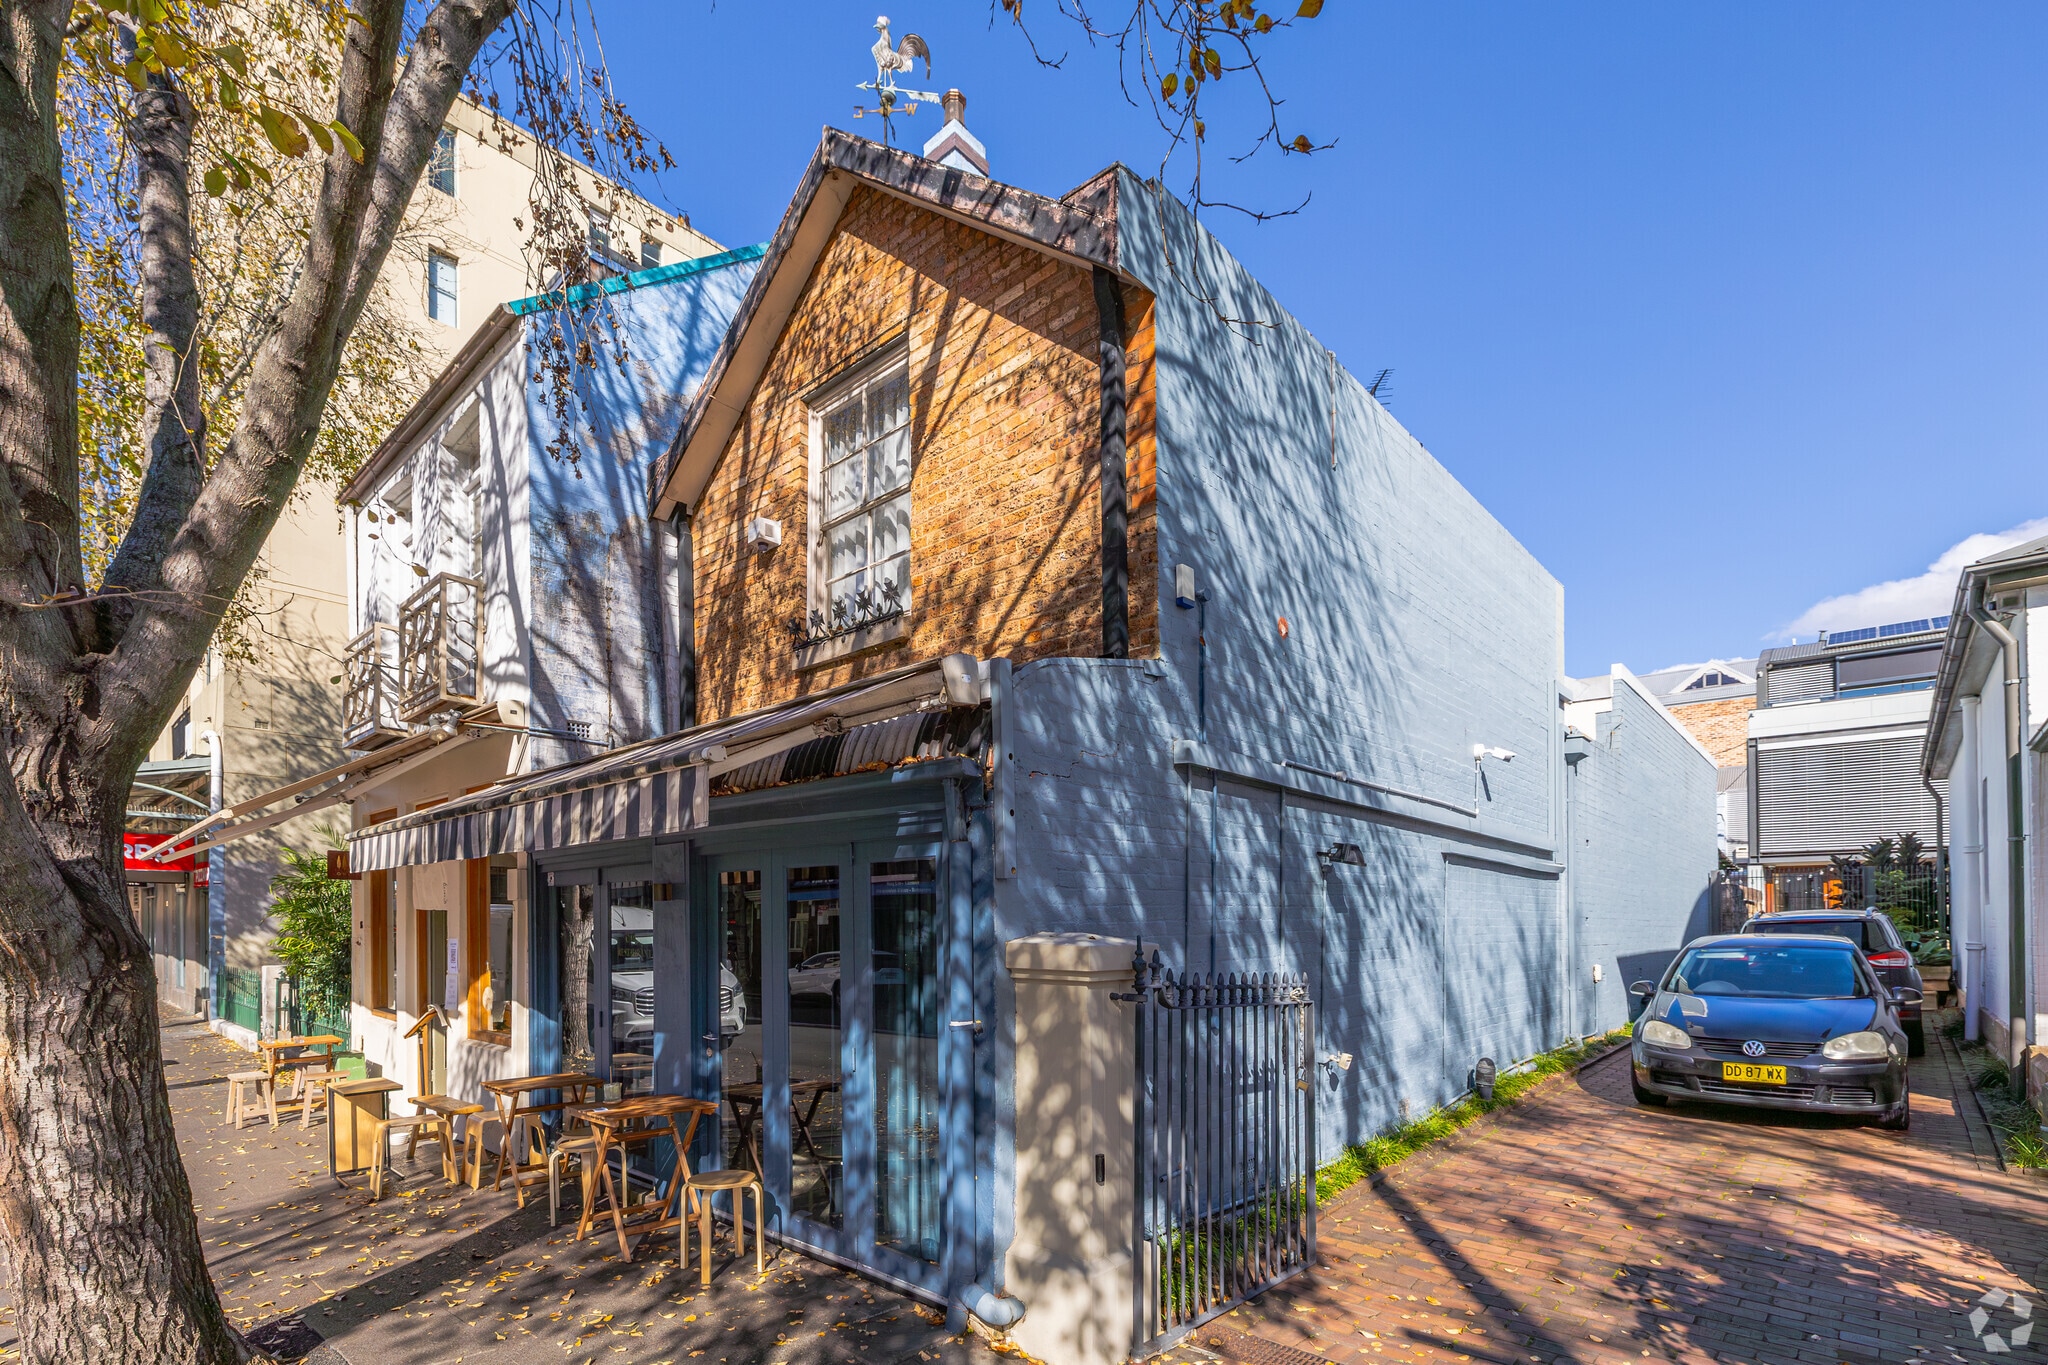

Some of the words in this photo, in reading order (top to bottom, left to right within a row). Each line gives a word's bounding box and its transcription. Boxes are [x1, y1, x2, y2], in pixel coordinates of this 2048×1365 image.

[1725, 1065, 1742, 1077] DD
[1745, 1067, 1761, 1078] 87
[1766, 1068, 1783, 1080] WX
